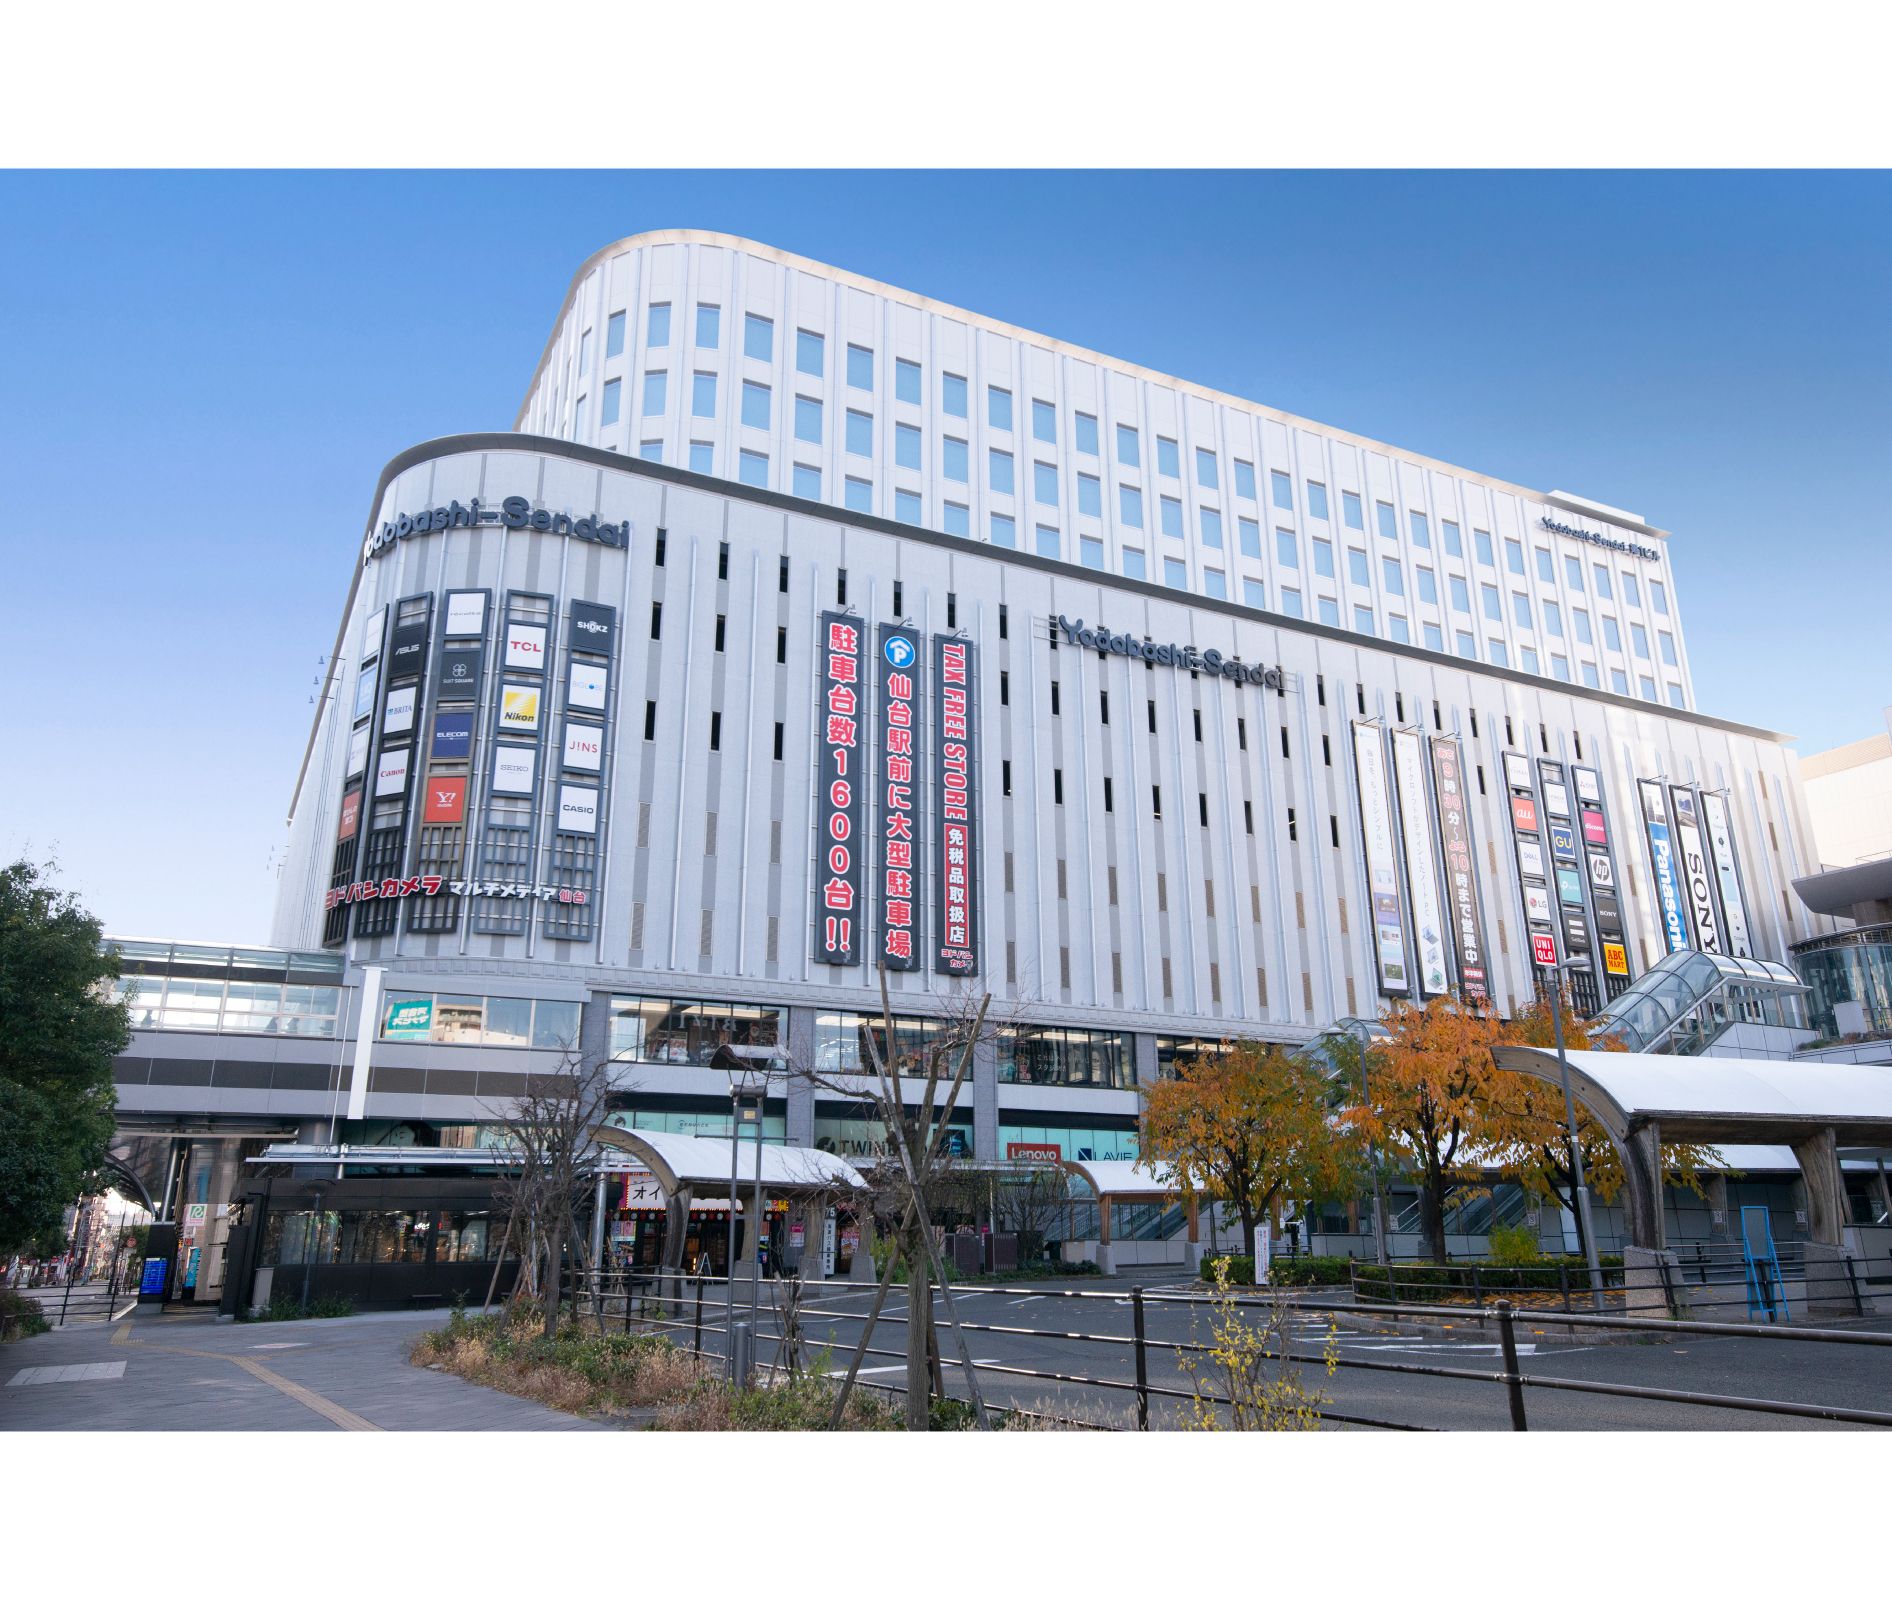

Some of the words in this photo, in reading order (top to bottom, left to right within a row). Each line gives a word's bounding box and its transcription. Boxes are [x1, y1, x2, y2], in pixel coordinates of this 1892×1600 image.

[395, 643, 420, 656] ASUS
[510, 640, 541, 653] TCL
[943, 643, 966, 685] TAX
[393, 705, 413, 715] BRITA
[943, 687, 967, 741] FREE
[504, 711, 535, 723] Nikon
[436, 731, 468, 739] ELECOM
[380, 767, 405, 778] Canon
[500, 764, 529, 773] SEIKO
[943, 743, 968, 821] STORE
[563, 804, 593, 814] CASIO
[886, 673, 912, 958] 仙台駅前に大型駐車場
[1516, 809, 1533, 819] au
[1555, 836, 1572, 849] GU
[1595, 858, 1608, 881] hp
[948, 828, 965, 944] 免税品取扱店
[558, 888, 587, 905] 仙台
[1654, 839, 1687, 952] Panasoni
[1687, 852, 1718, 954] SONY
[1599, 910, 1617, 918] SONY
[1535, 939, 1551, 950] UNI
[1537, 950, 1553, 961] QLO
[1607, 949, 1623, 960] ABC
[1607, 960, 1625, 969] MART
[1011, 1148, 1056, 1161] Lenovo
